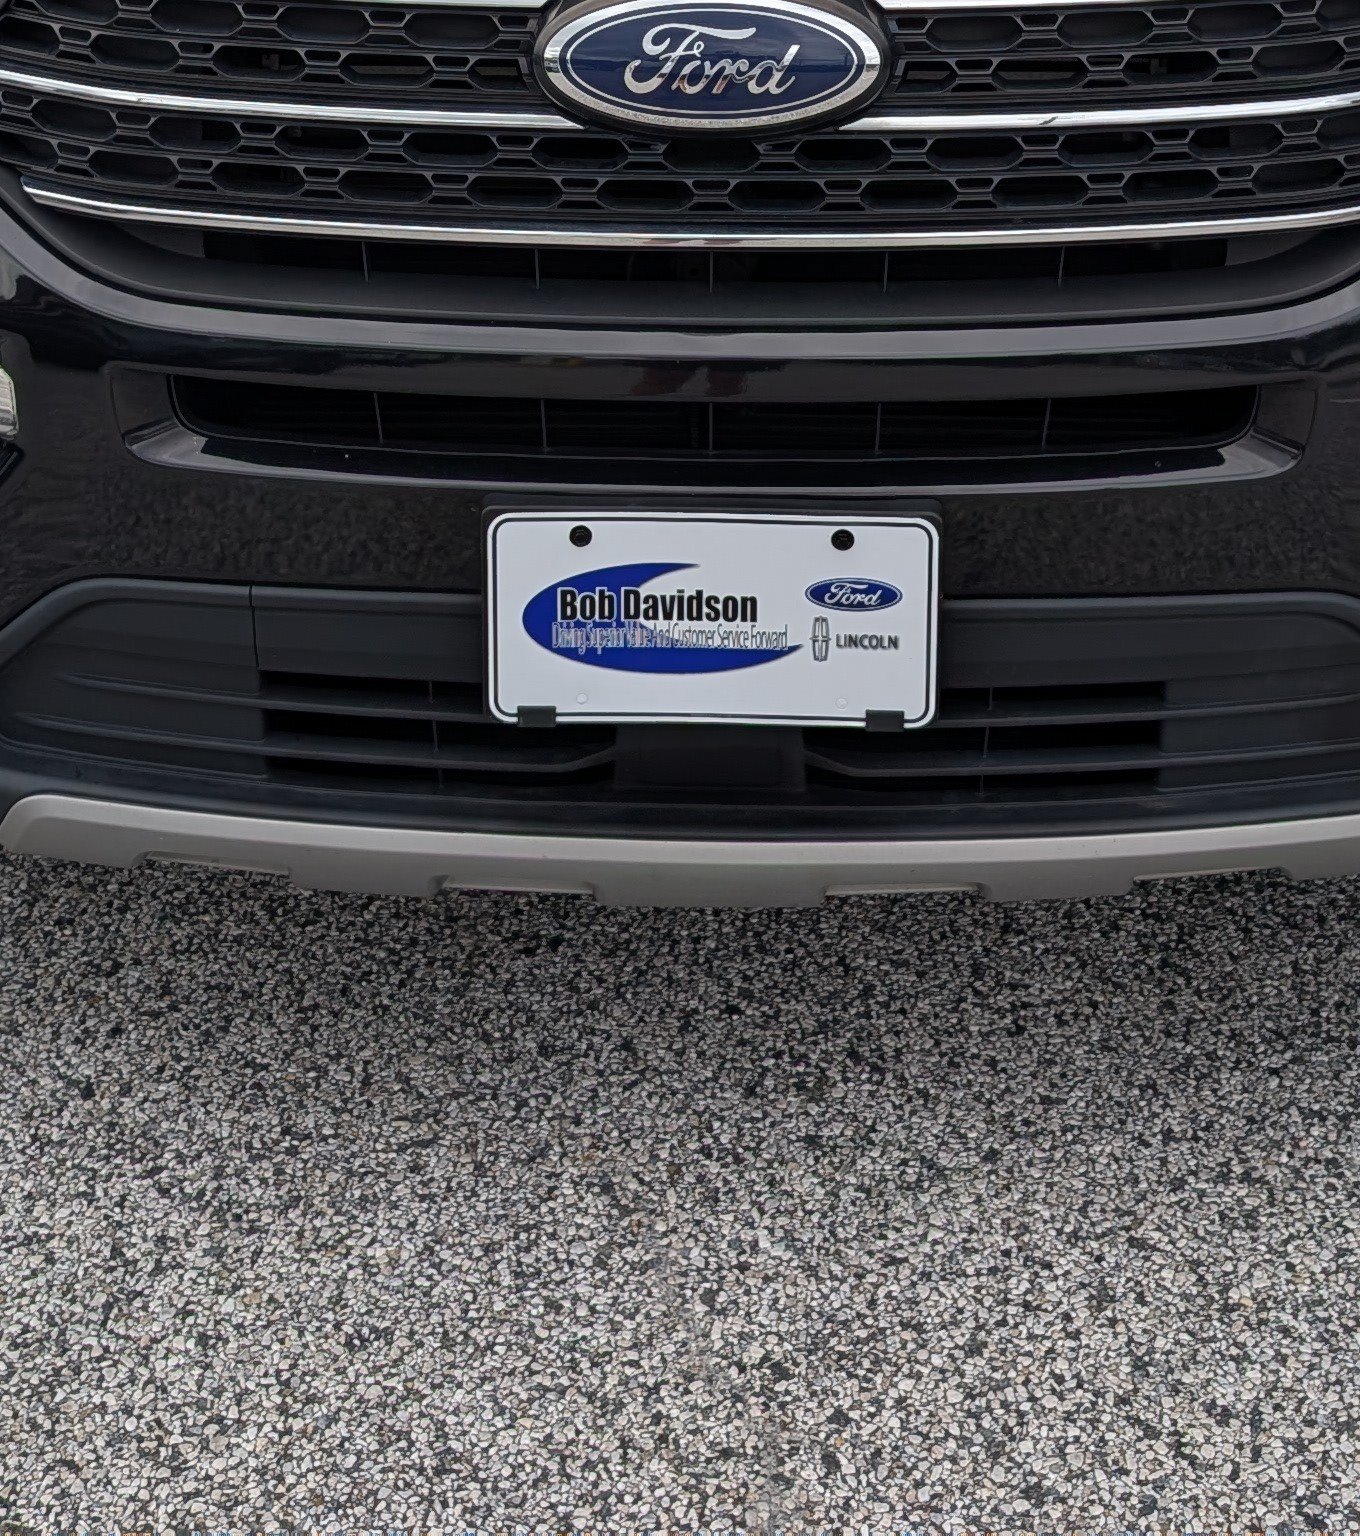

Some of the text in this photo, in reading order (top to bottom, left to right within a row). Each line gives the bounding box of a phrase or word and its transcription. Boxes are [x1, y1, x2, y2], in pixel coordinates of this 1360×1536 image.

[623, 22, 801, 95] Ford
[558, 587, 758, 623] Bob Davidson
[824, 582, 882, 605] Ford
[552, 621, 788, 654] Driving Superior Value And Customer Service Forward
[835, 633, 899, 650] LINCOLN
